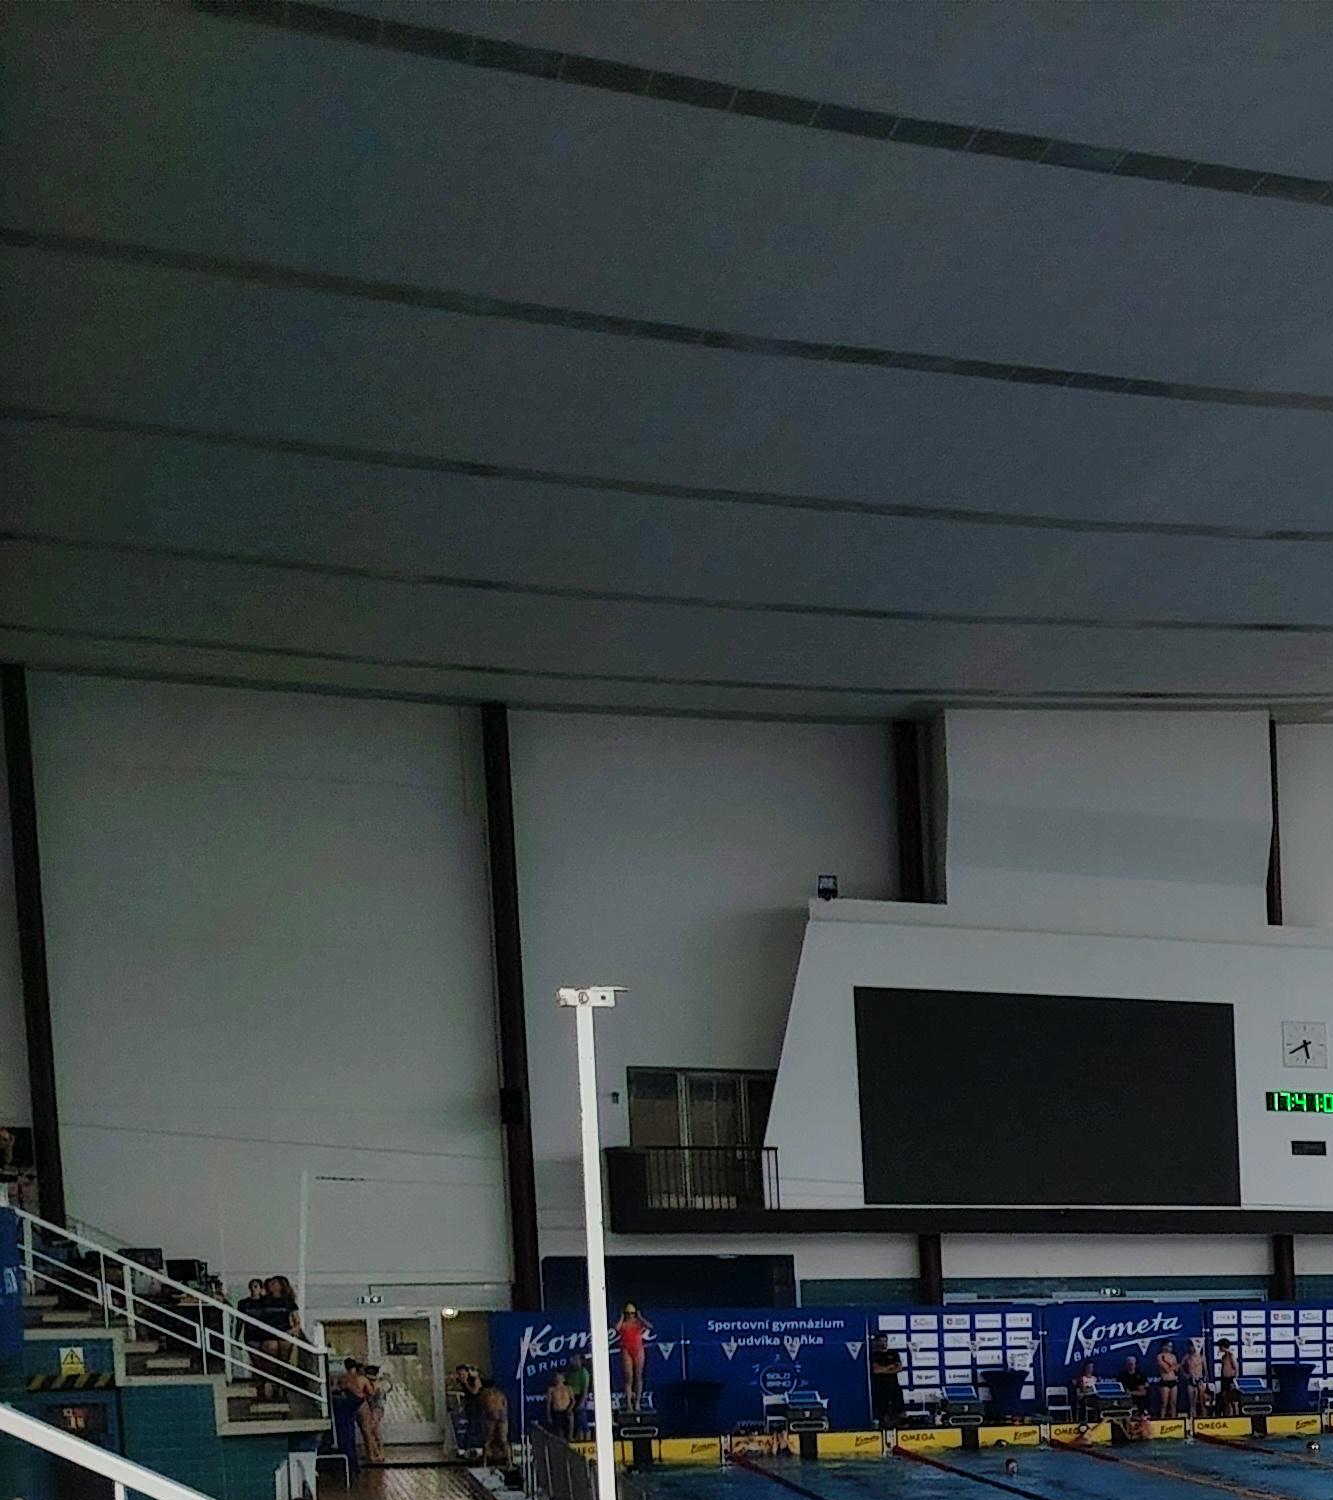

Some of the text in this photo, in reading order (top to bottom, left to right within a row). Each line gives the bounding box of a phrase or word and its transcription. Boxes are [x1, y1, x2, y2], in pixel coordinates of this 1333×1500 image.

[707, 1317, 845, 1333] Sportovní gymnázium
[1064, 1311, 1183, 1366] Kometa
[526, 1357, 568, 1377] BRNO
